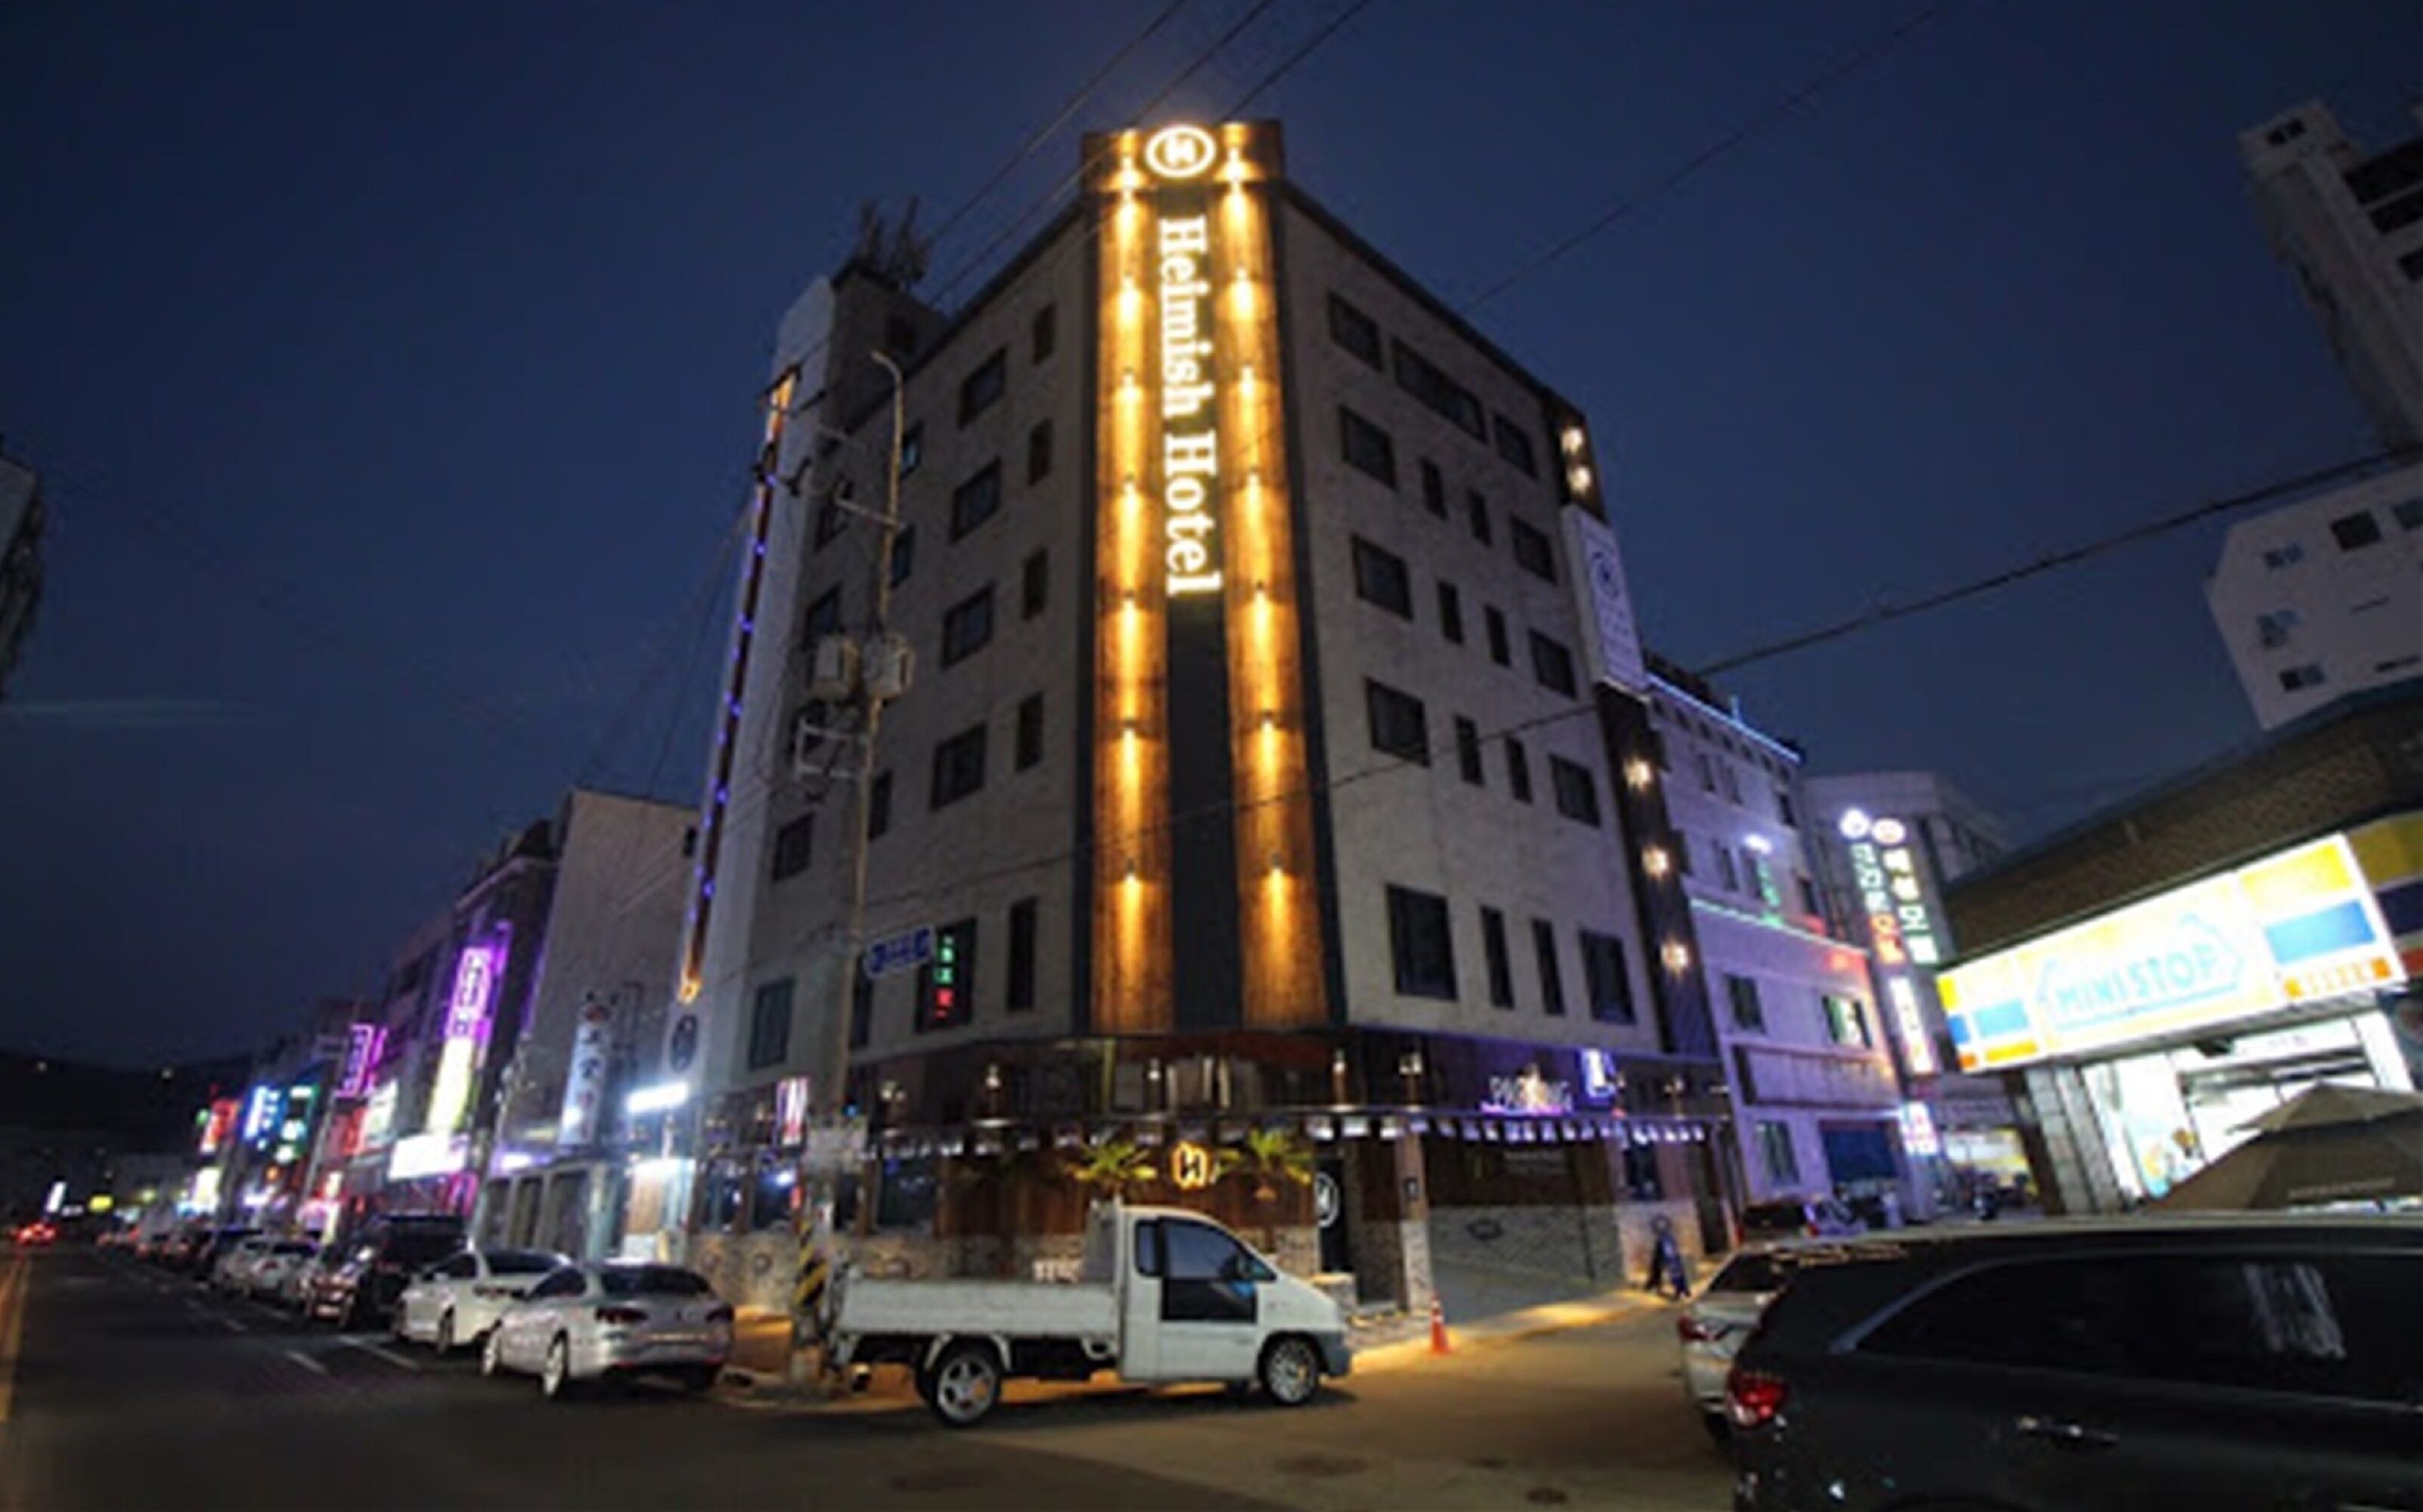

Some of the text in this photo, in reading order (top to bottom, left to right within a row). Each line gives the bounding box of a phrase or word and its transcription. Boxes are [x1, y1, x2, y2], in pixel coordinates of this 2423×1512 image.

[1157, 215, 1223, 598] Heimish Hotel
[2054, 942, 2218, 1016] MINISTOP
